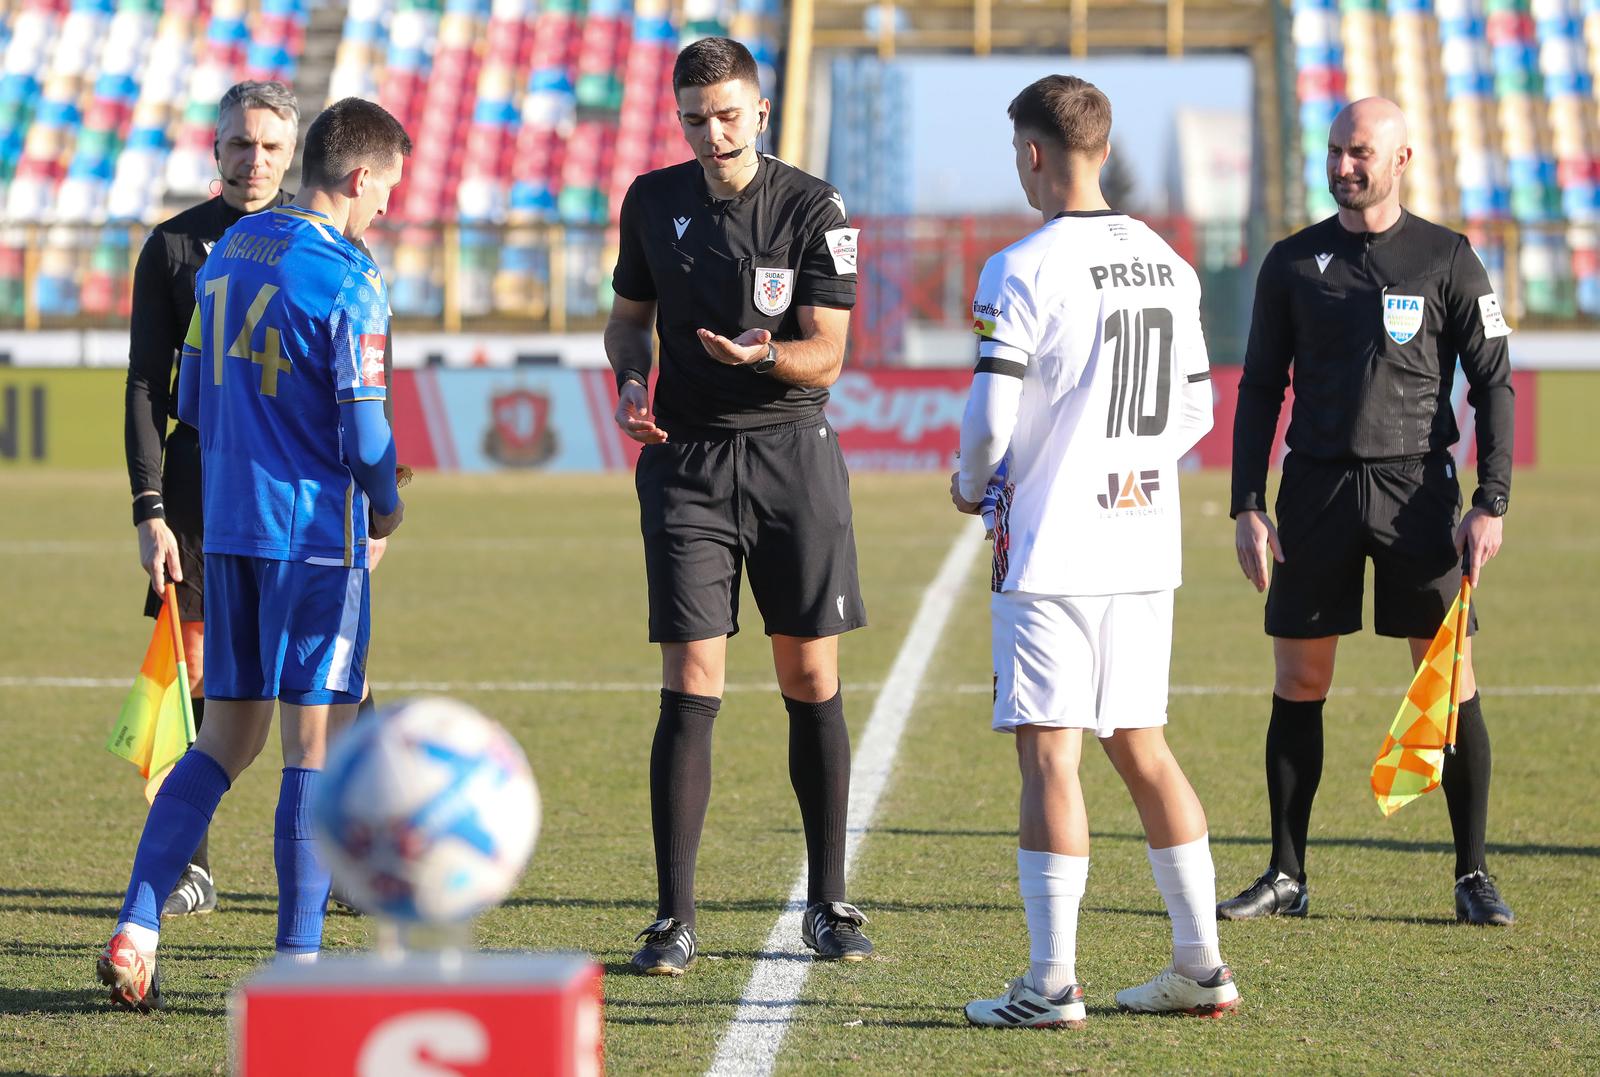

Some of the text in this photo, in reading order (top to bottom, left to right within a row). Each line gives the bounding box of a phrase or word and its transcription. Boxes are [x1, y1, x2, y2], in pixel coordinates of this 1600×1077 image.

[223, 233, 294, 267] MARIĆ
[1089, 256, 1175, 290] PRŠIR
[1387, 298, 1419, 311] FIFA
[205, 274, 291, 397] 14
[1104, 307, 1174, 439] 10
[1096, 469, 1161, 510] JAF
